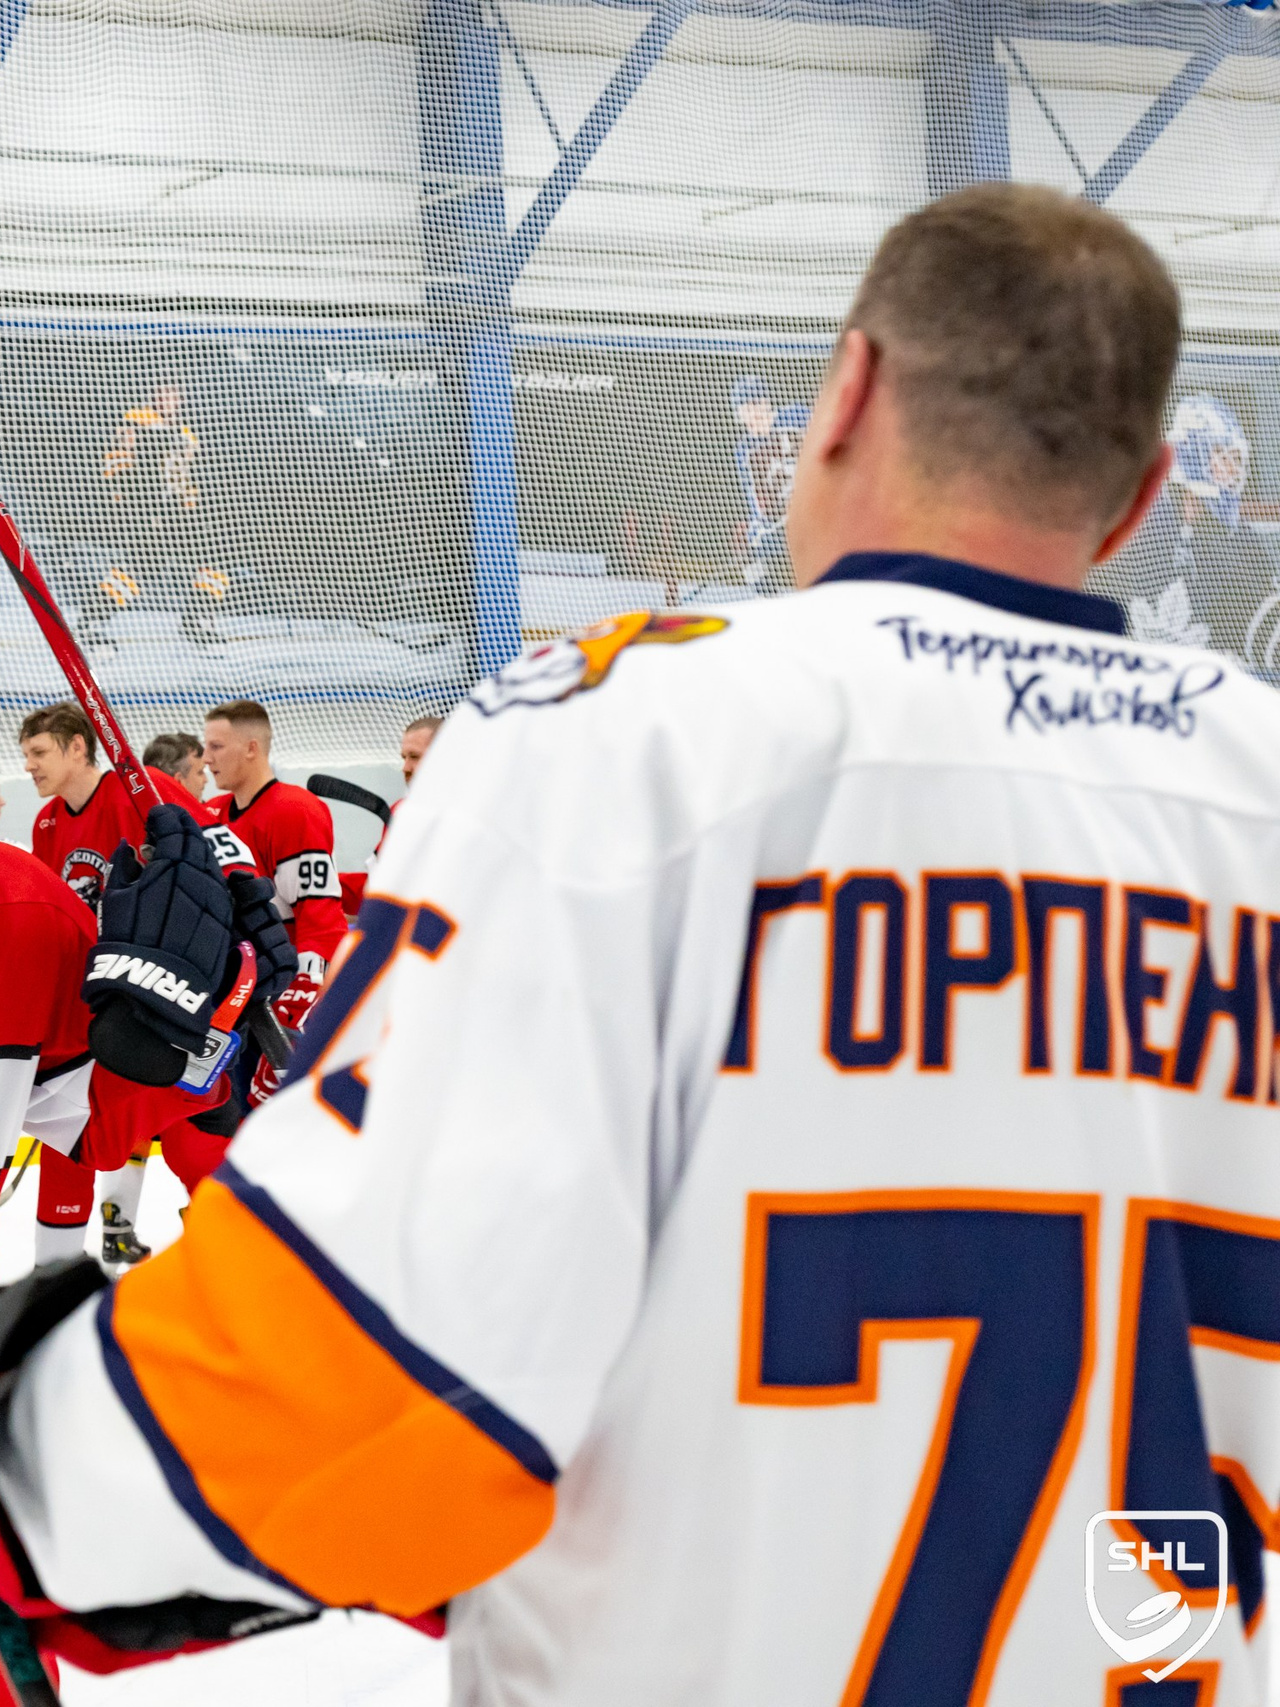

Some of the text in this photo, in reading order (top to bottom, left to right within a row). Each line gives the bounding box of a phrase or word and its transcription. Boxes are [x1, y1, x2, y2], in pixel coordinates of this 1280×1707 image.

[1005, 662, 1224, 738] Хомяков
[298, 860, 329, 890] 99
[86, 953, 210, 1015] PRIME
[230, 979, 253, 1008] SHL
[718, 869, 1280, 1108] ГОРПЕН
[736, 1187, 1280, 1707] 75
